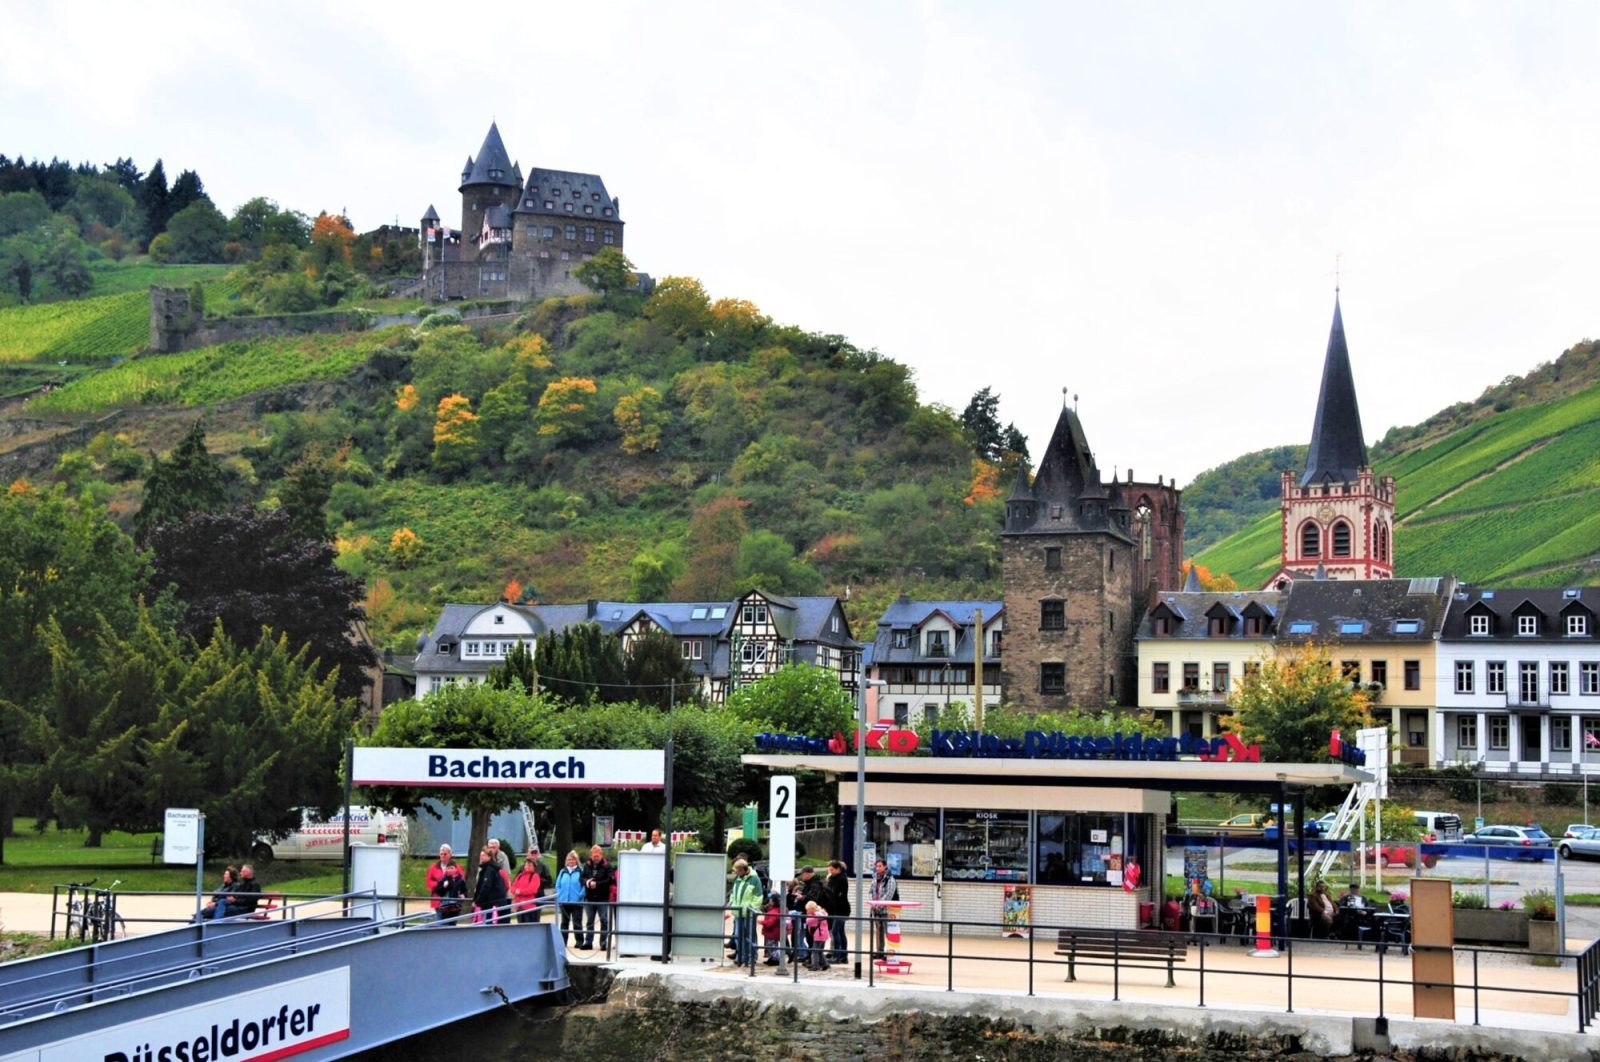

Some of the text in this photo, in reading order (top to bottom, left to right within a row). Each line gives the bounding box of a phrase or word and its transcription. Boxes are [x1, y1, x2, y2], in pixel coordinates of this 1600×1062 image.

[853, 719, 920, 754] KD
[428, 754, 585, 779] Bacharach
[167, 811, 197, 819] Bacharach
[775, 785, 790, 818] 2
